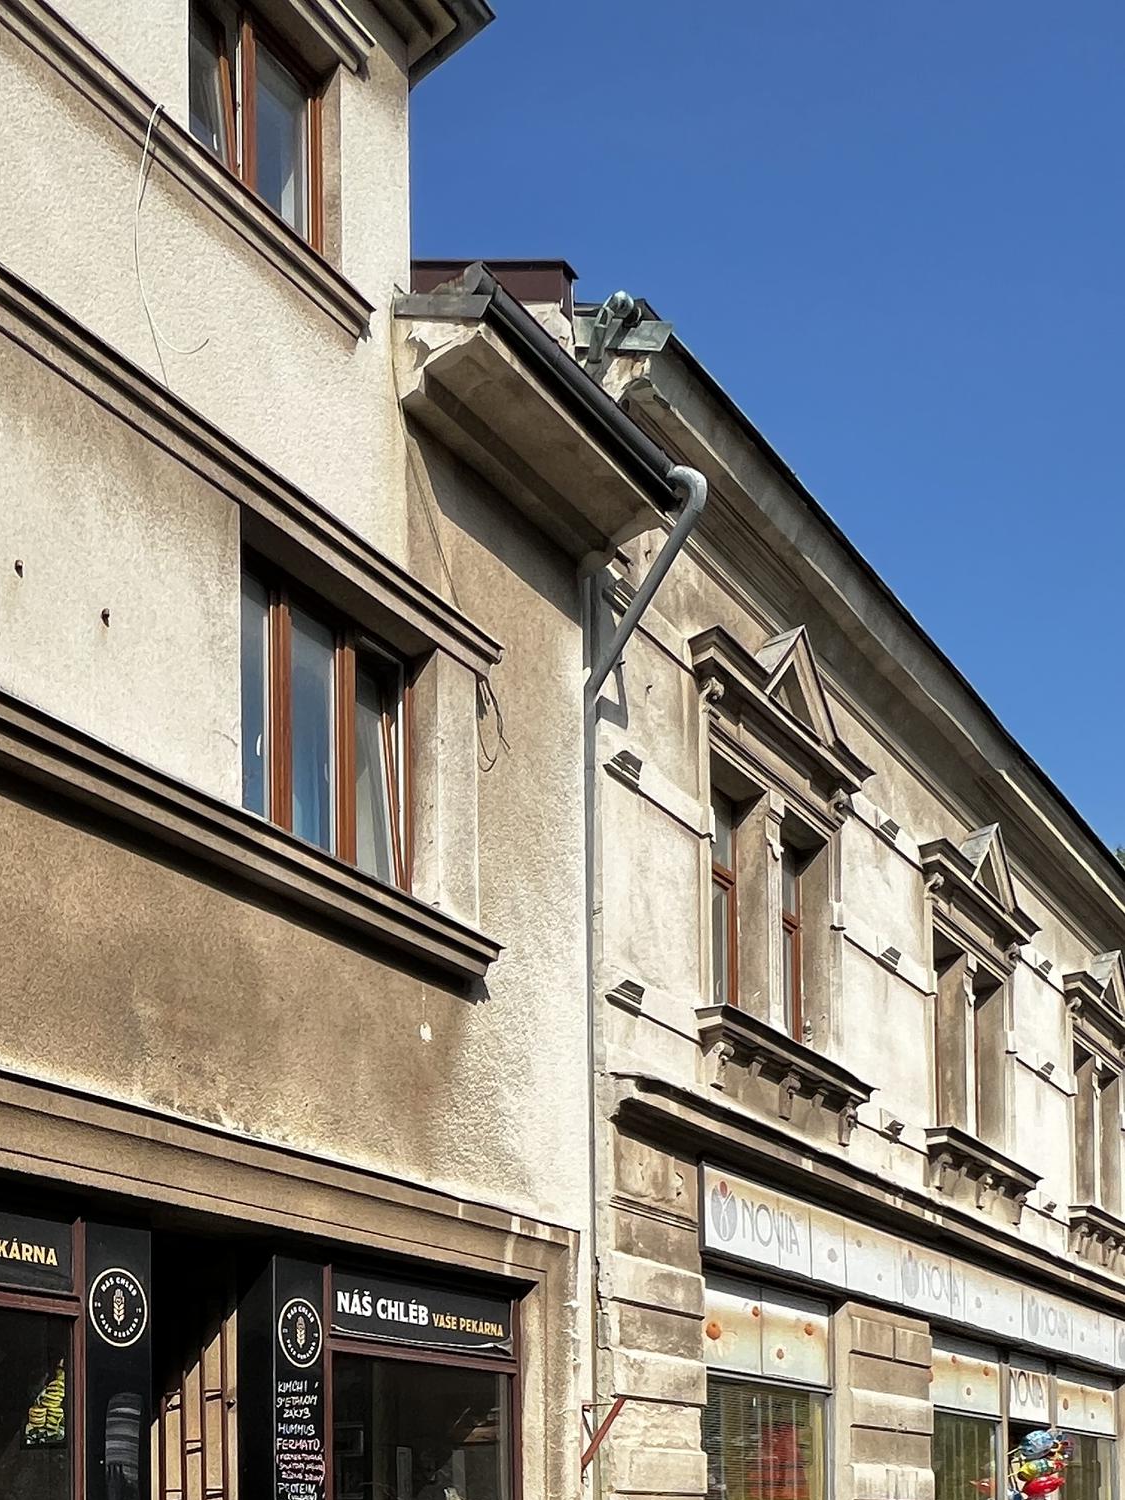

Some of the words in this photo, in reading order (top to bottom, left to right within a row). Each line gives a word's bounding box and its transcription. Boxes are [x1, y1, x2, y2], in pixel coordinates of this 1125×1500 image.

[336, 1289, 372, 1317] NÁŠ
[376, 1299, 429, 1326] CHLÉB
[432, 1312, 457, 1331] VAŠE
[459, 1317, 504, 1338] PEKÁRNA
[277, 1380, 308, 1393] KIMCHI
[277, 1422, 315, 1436] HUMMUS
[277, 1482, 316, 1495] PROTEIN
